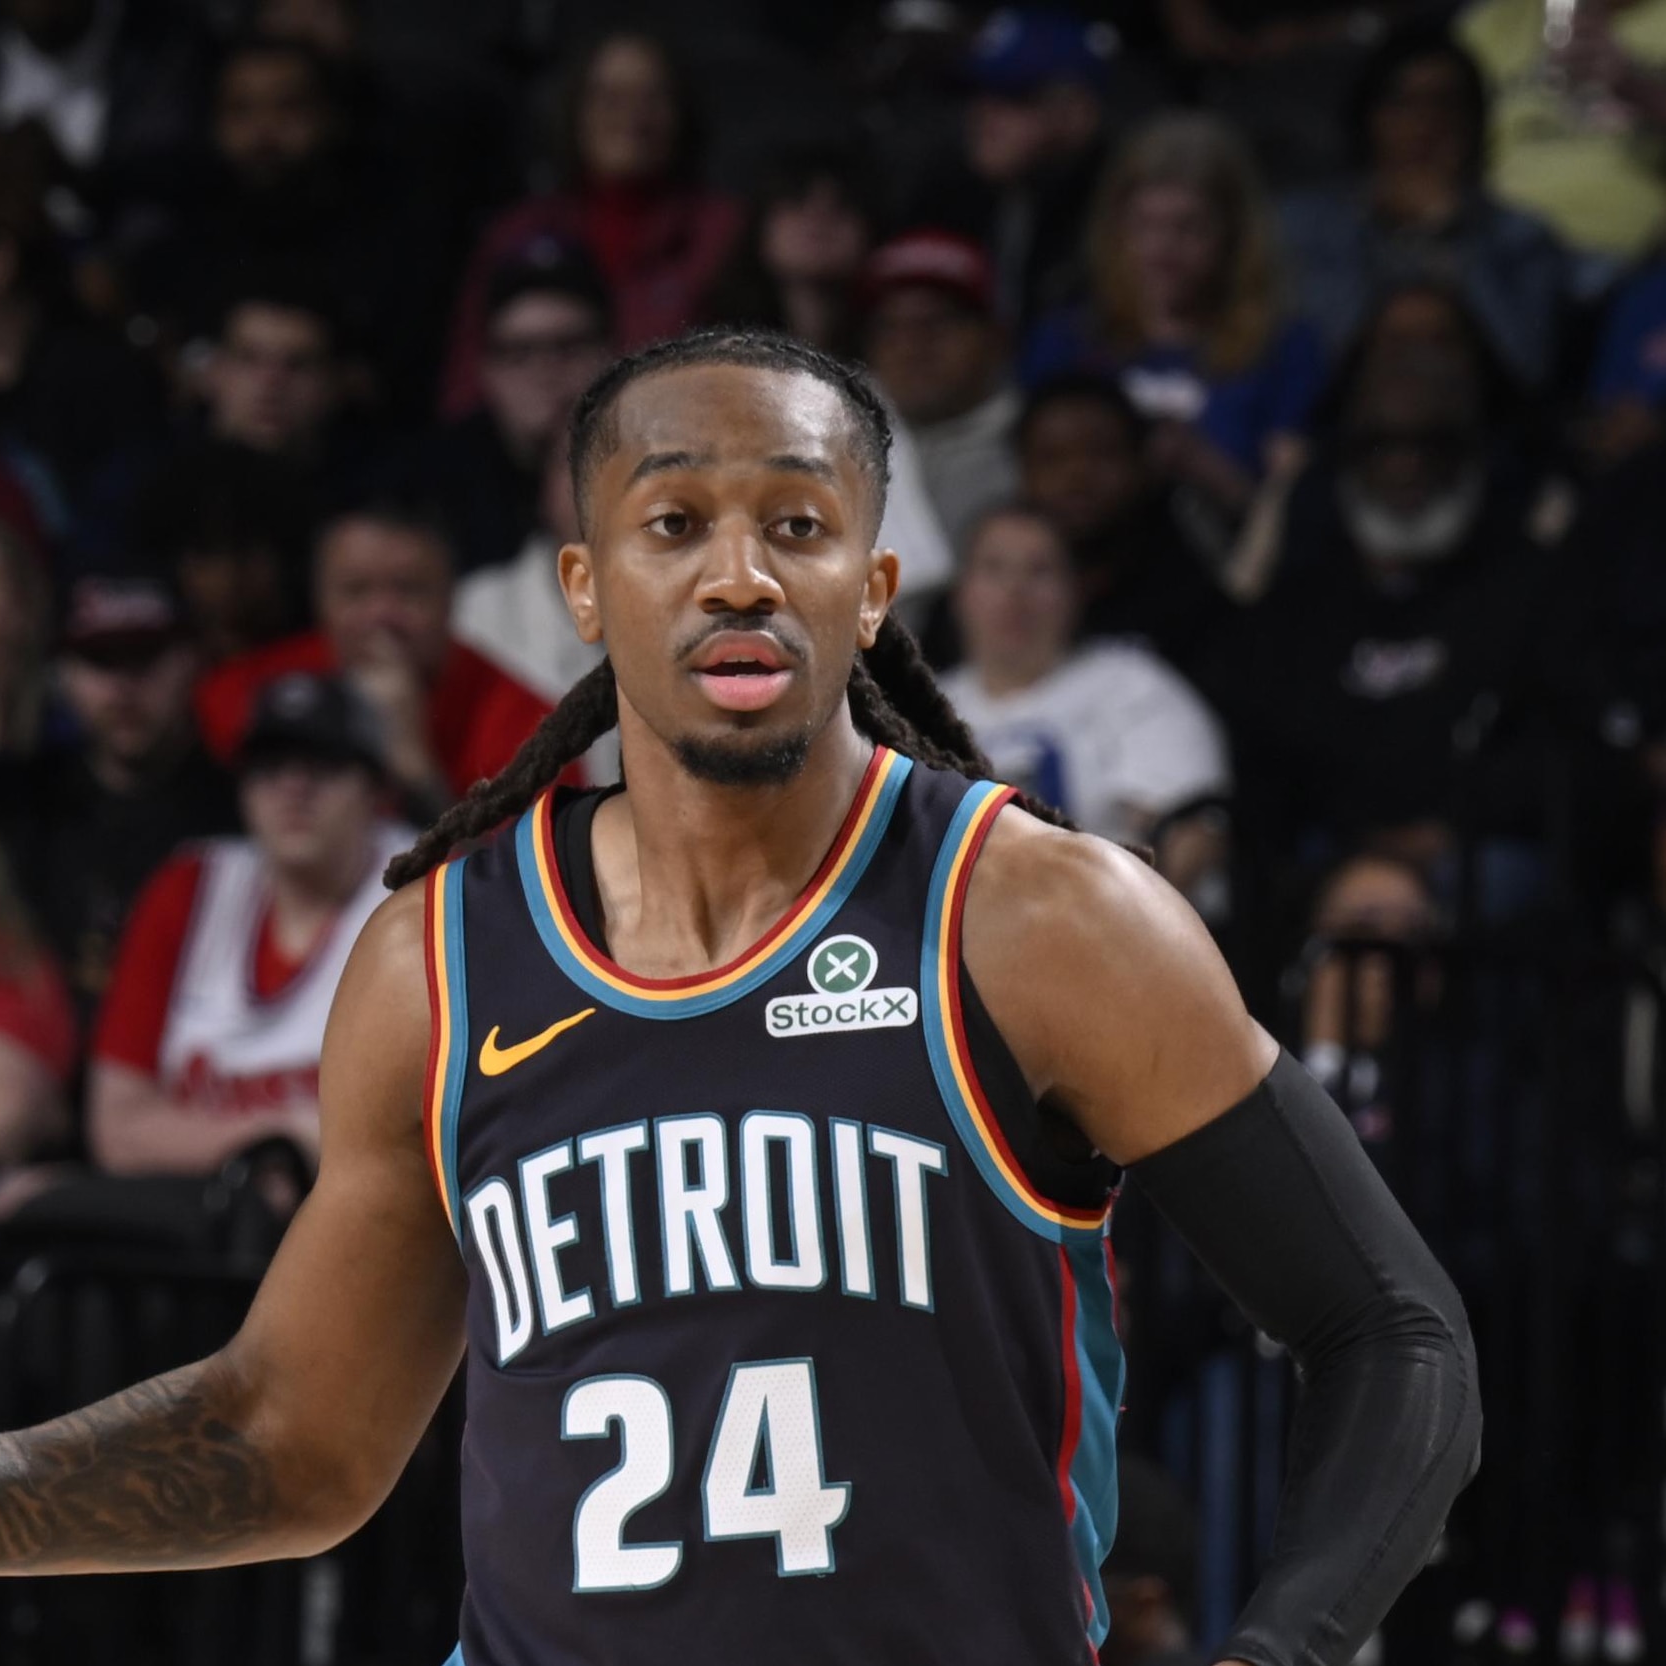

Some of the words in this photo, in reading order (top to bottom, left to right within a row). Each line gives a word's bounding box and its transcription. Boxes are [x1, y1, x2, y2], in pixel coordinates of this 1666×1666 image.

[771, 992, 910, 1031] StockX
[462, 1108, 949, 1369] DETROIT
[559, 1355, 853, 1594] 24
